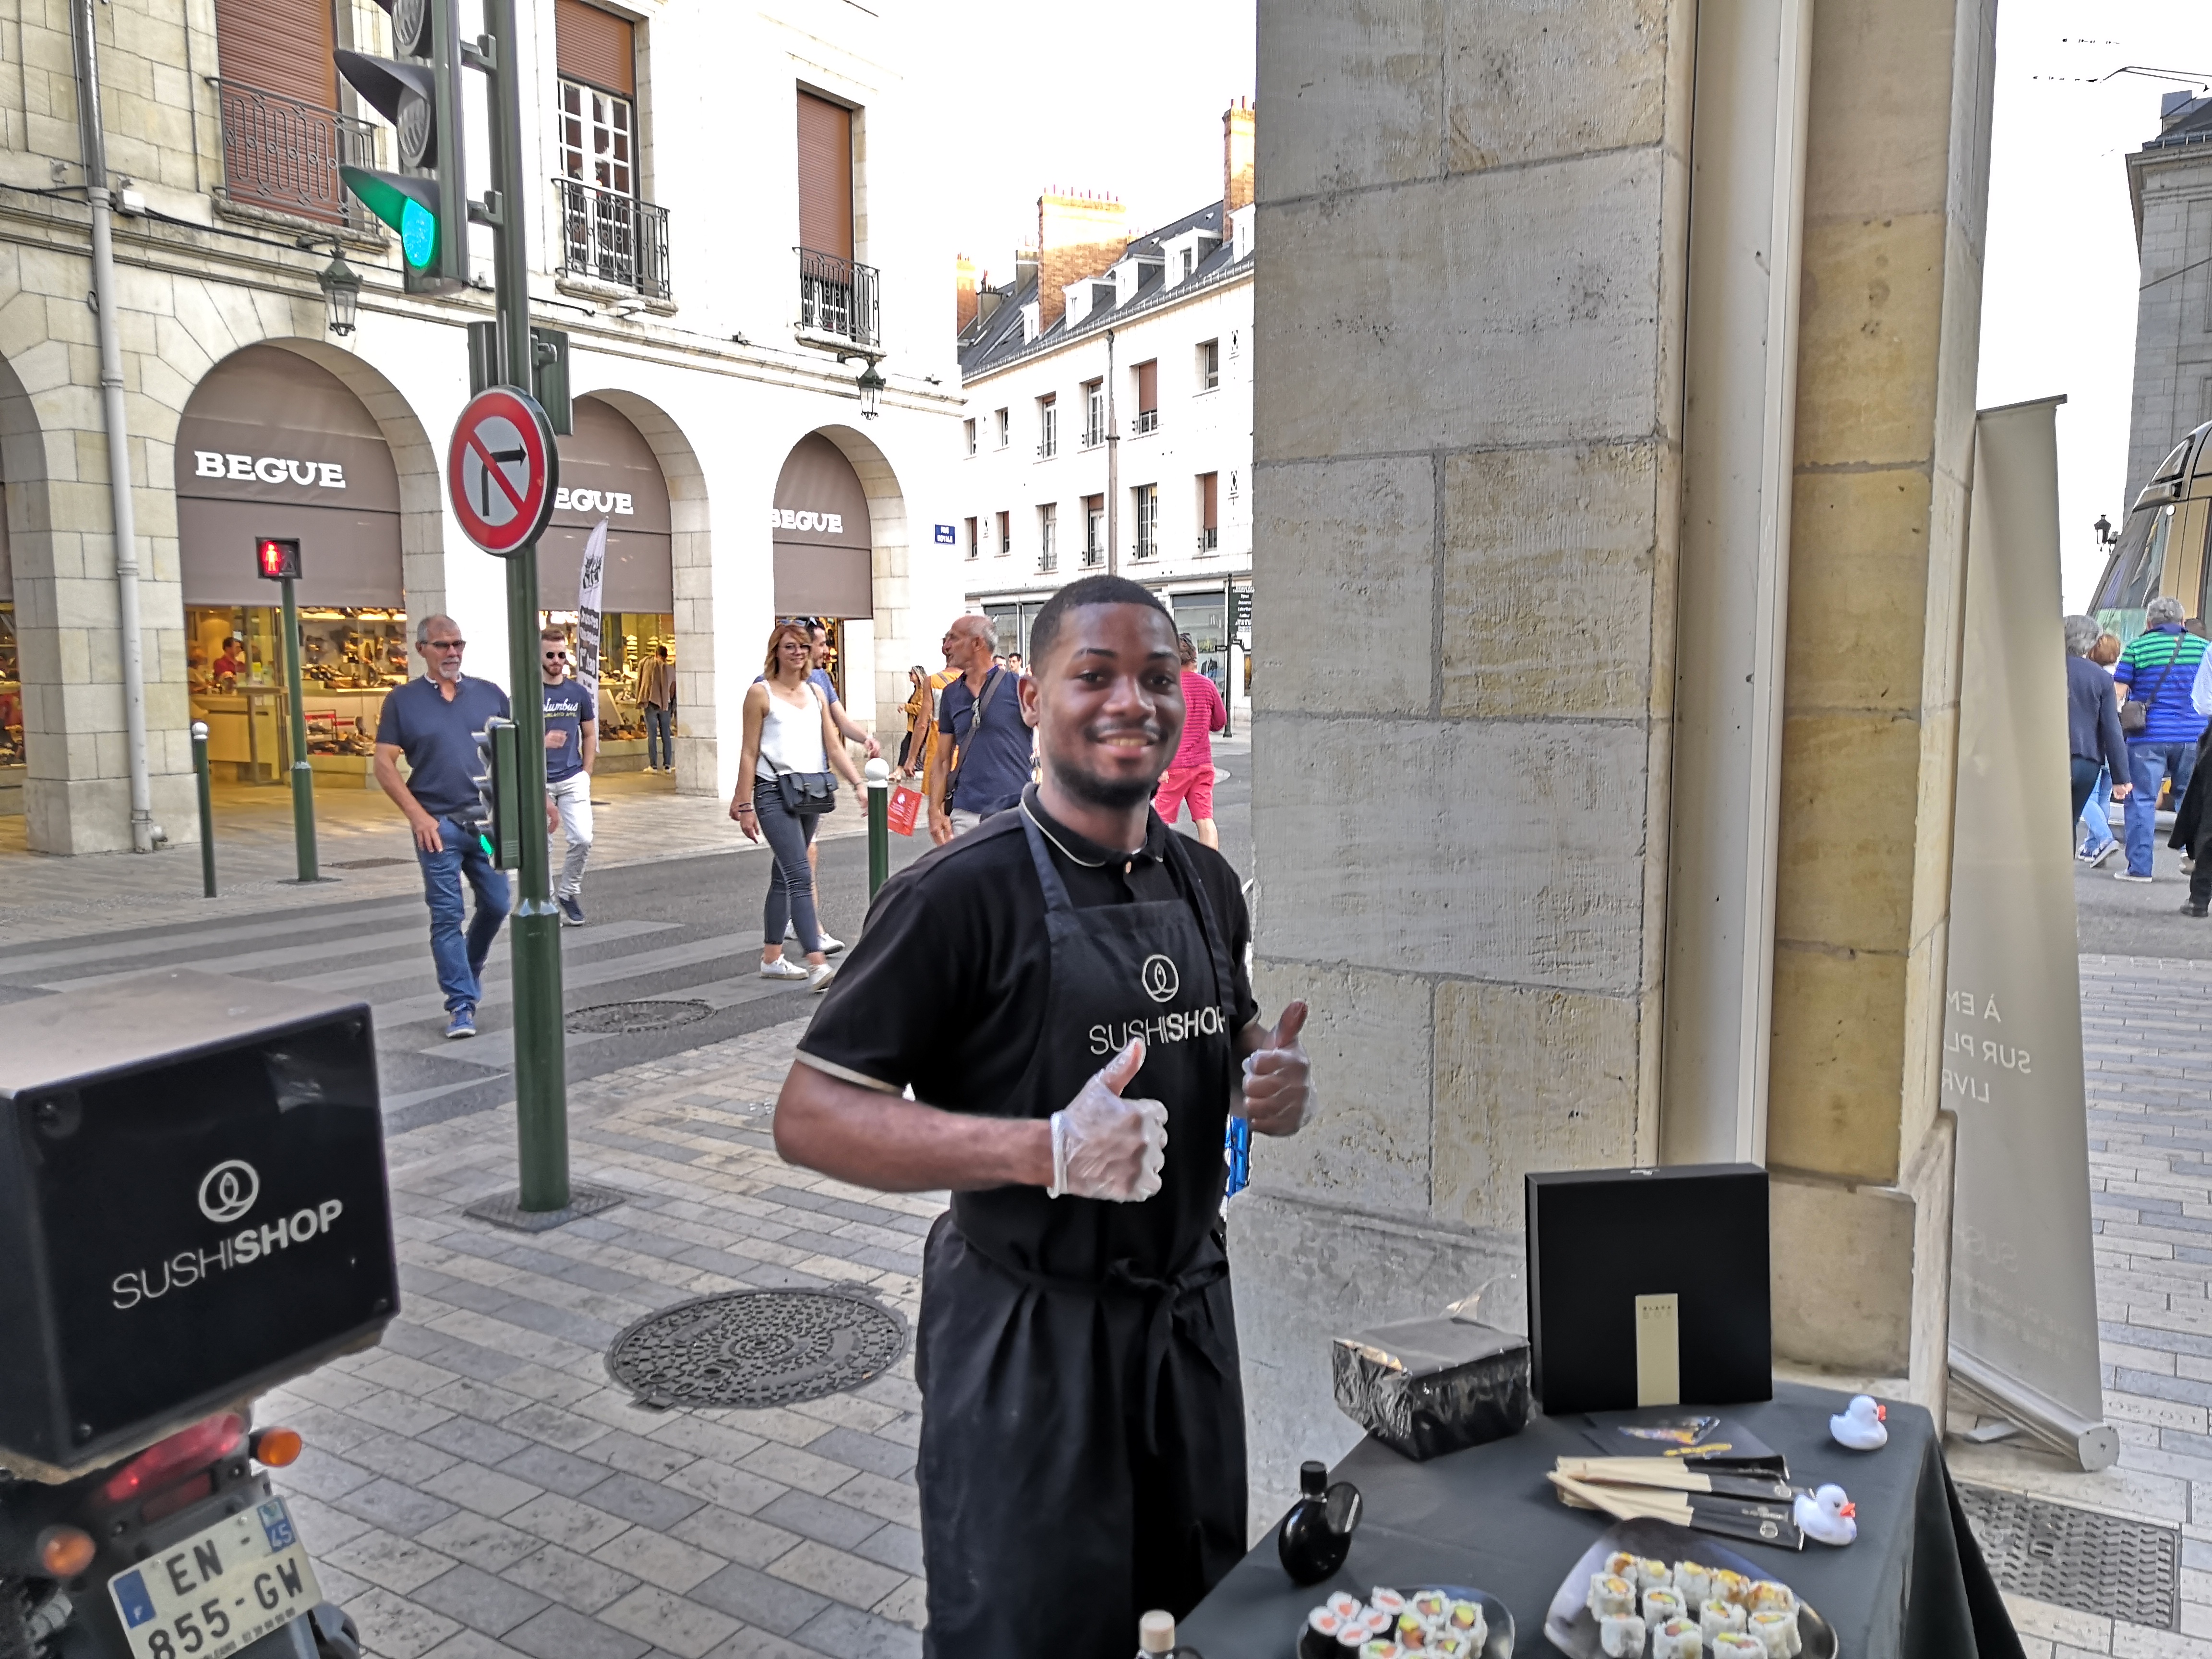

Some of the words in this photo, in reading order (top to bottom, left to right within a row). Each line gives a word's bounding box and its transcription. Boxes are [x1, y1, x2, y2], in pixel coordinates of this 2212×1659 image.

[194, 450, 346, 488] BEGUE
[554, 487, 634, 515] EGUE
[772, 508, 843, 533] BEGUE
[112, 1199, 343, 1310] SUSHISHOP
[270, 1523, 293, 1547] 45
[166, 1539, 223, 1596] EN
